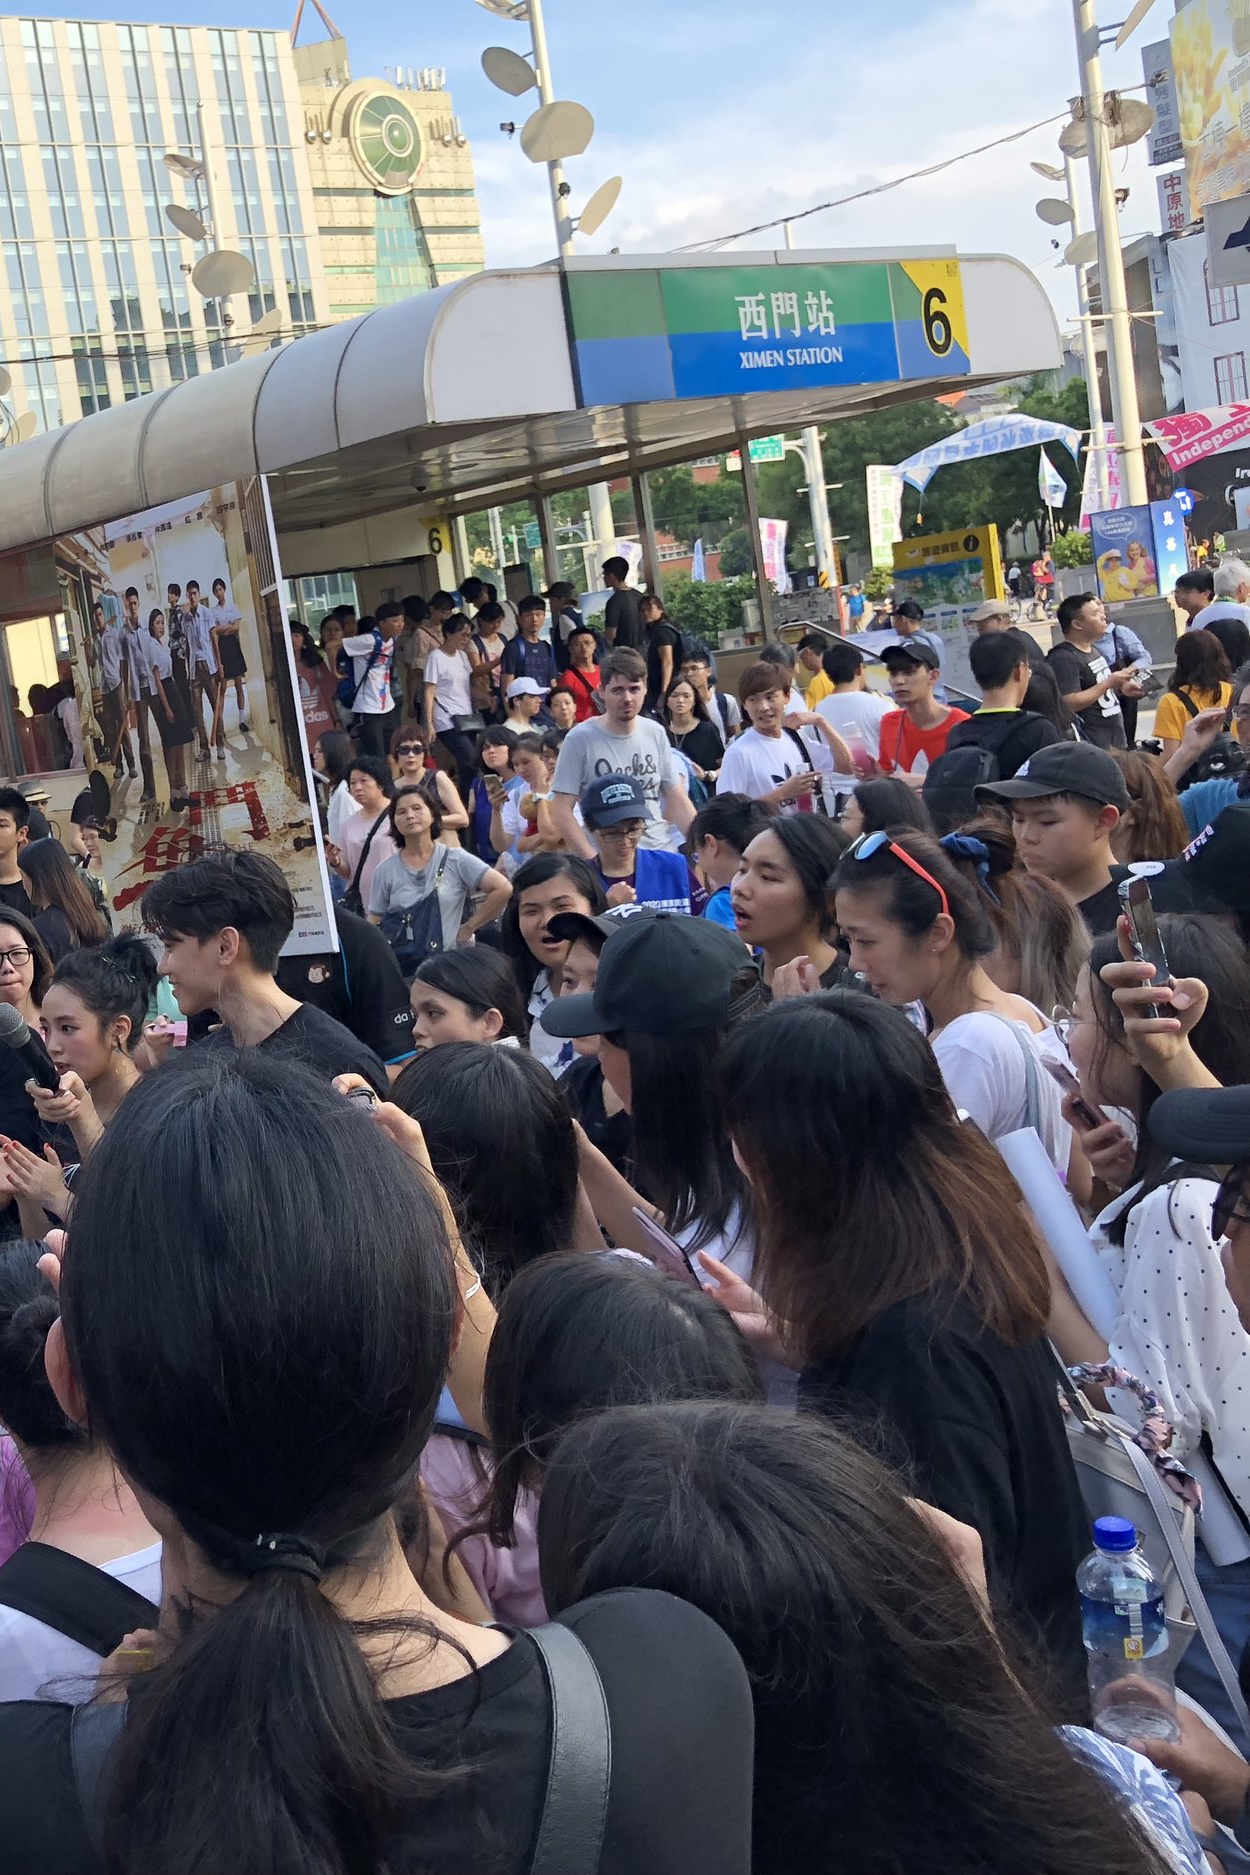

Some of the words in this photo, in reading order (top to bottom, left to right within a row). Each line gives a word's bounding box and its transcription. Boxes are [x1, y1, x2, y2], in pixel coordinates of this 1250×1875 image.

[733, 289, 838, 341] 西門站
[922, 286, 953, 357] 6
[738, 350, 785, 370] XIMEN
[786, 345, 844, 367] STATION
[428, 528, 443, 555] 6
